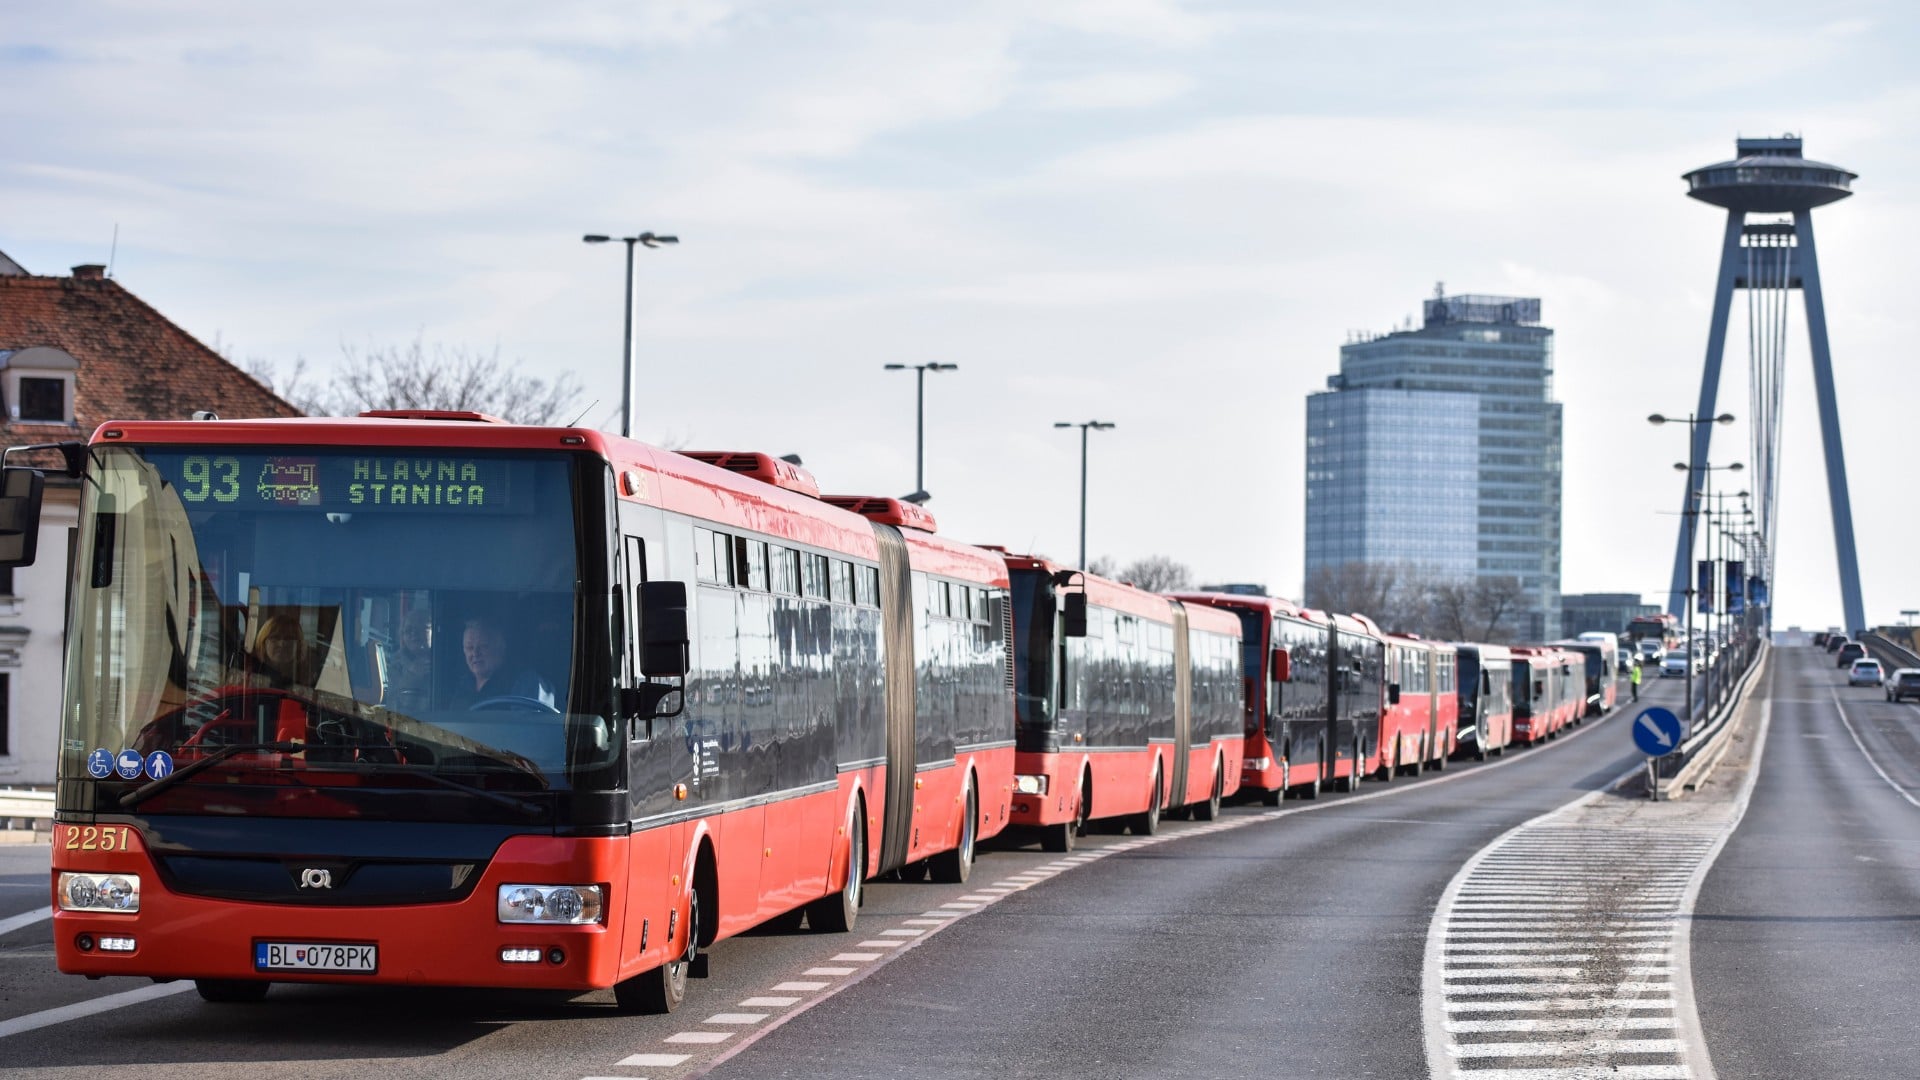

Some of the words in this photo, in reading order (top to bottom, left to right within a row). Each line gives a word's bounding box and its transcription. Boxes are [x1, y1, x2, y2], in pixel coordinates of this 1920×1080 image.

[183, 456, 240, 502] 93
[349, 484, 484, 505] STANICA
[66, 826, 129, 851] 2251
[270, 946, 295, 966] BL
[307, 947, 371, 968] 078PK
